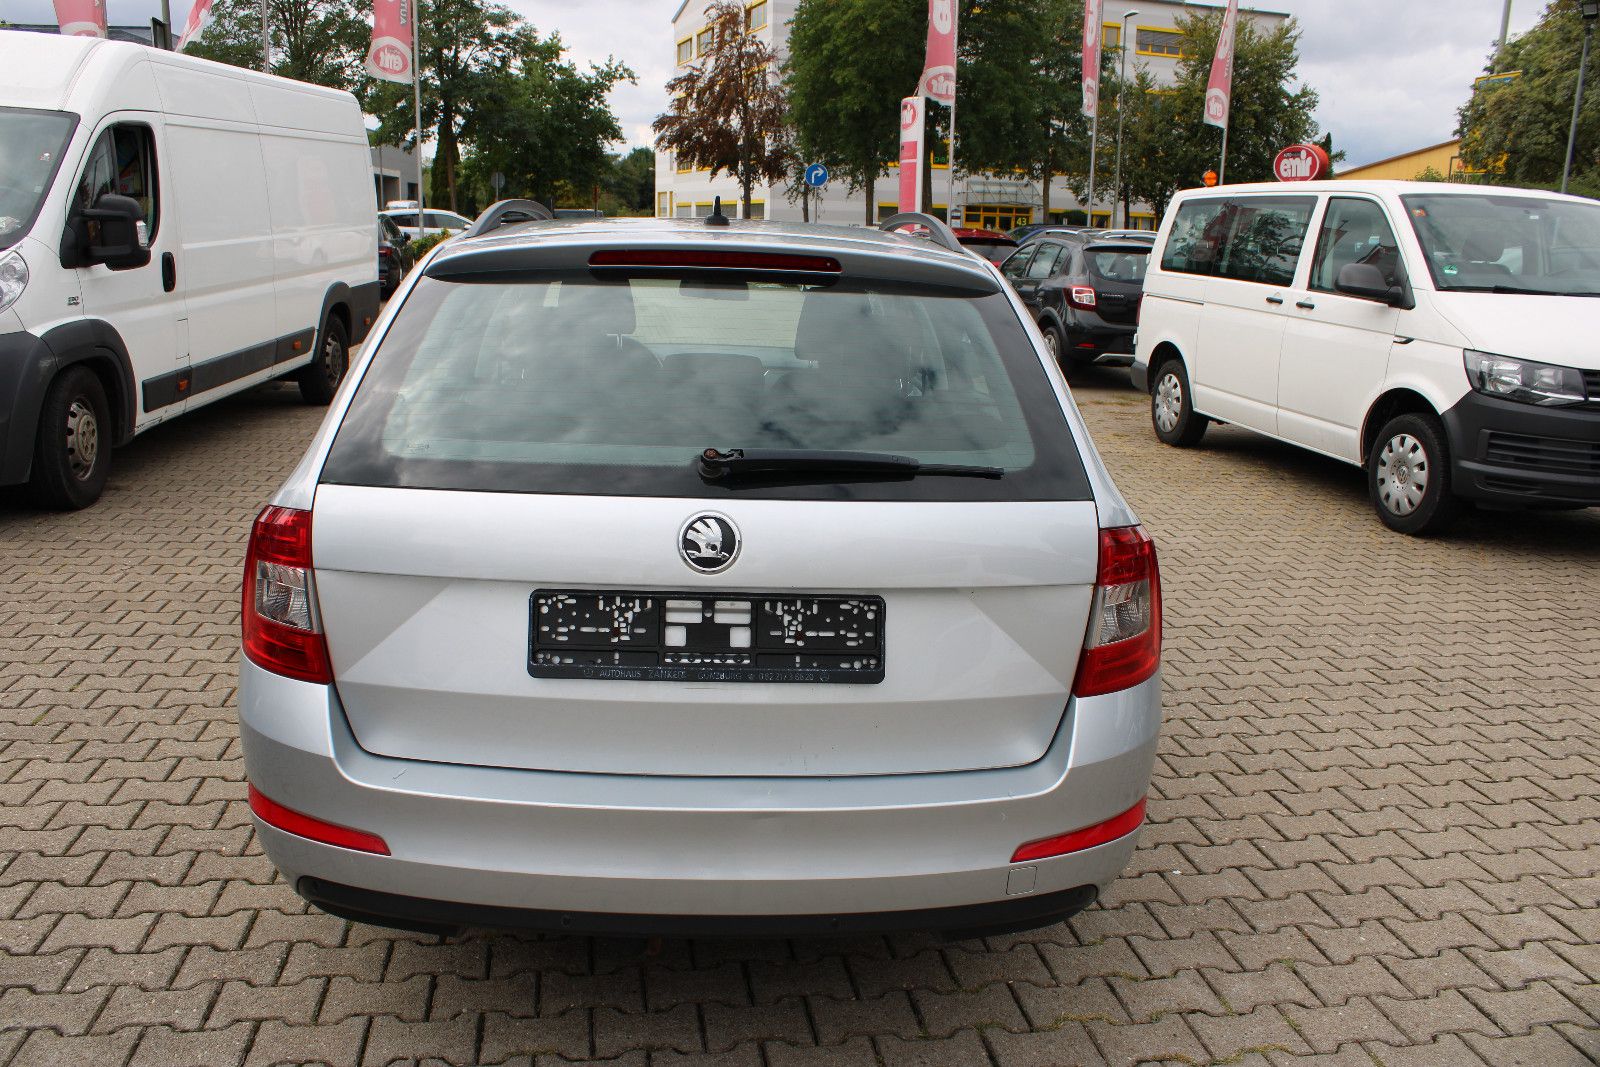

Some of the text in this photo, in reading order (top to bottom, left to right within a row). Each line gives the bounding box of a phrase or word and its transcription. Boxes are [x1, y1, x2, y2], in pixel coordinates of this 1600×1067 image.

[1280, 149, 1312, 177] emir
[1016, 217, 1027, 226] 43
[599, 669, 642, 678] AUTOHAUS
